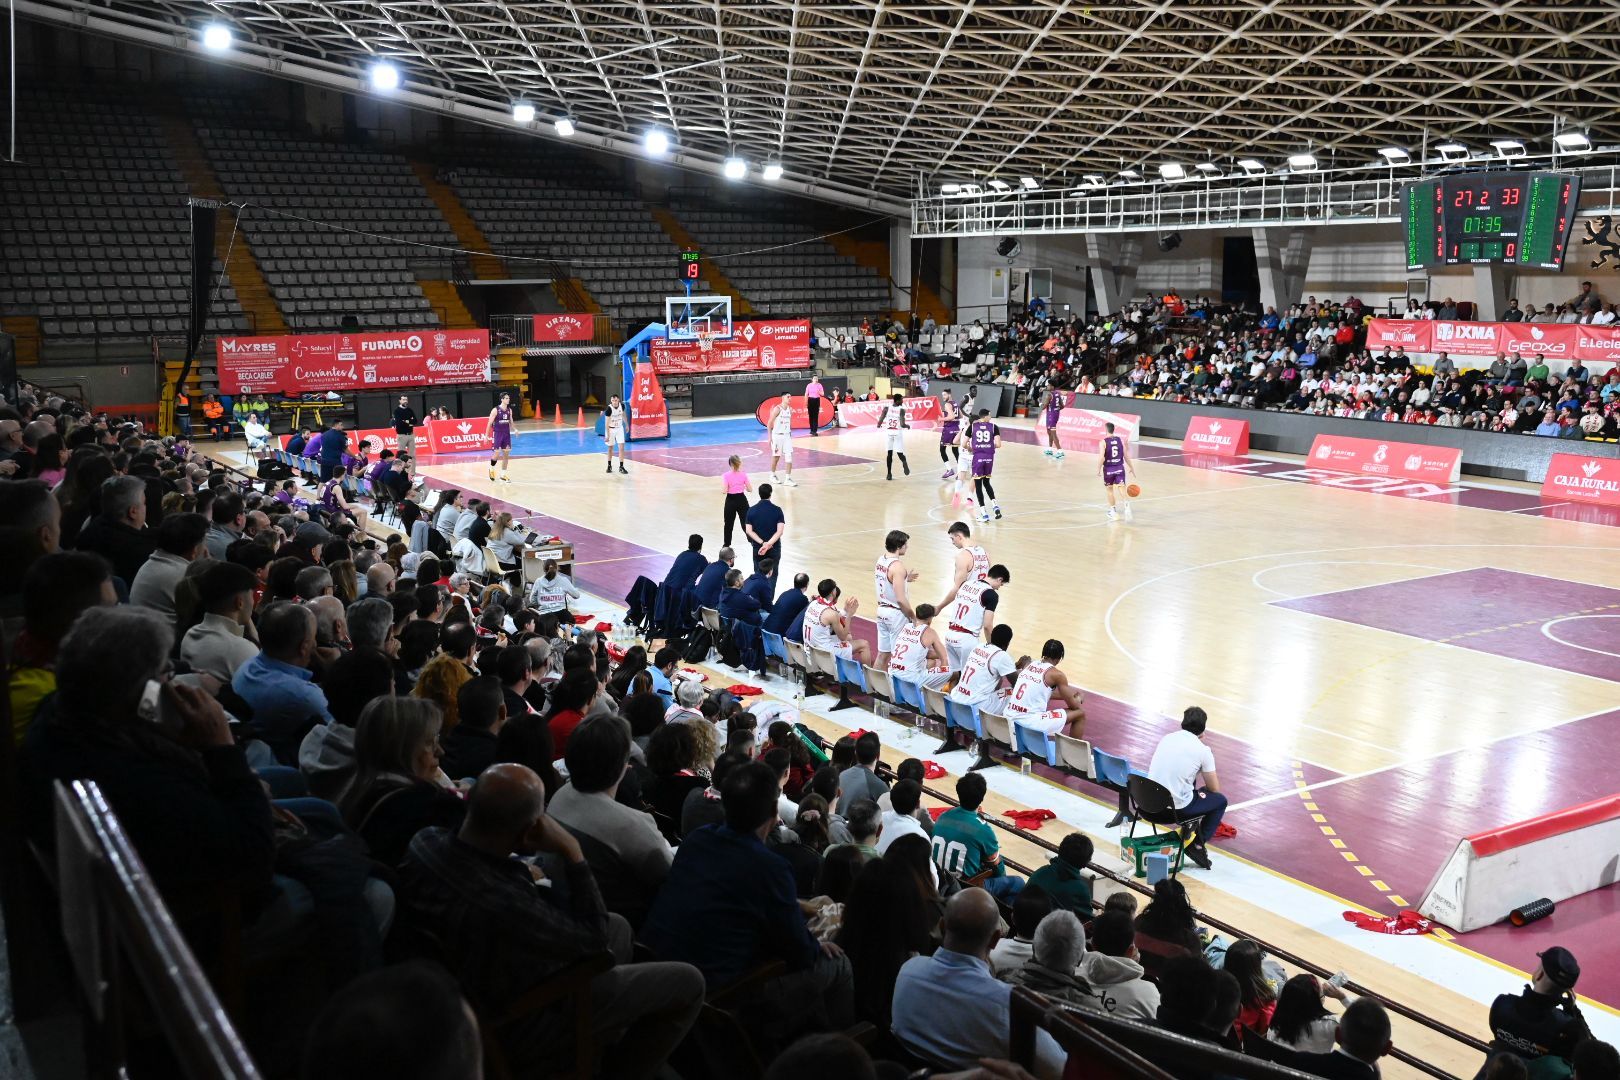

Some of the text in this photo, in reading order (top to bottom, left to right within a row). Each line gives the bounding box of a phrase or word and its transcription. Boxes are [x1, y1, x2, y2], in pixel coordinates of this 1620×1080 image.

[1455, 191, 1472, 207] 27
[1480, 191, 1489, 205] 2
[1502, 188, 1519, 205] 33
[1463, 216, 1501, 233] 07:35
[1453, 245, 1458, 257] 1
[1506, 243, 1515, 257] 0
[688, 263, 698, 278] 19
[545, 316, 582, 329] URZAPA
[774, 326, 807, 334] HYUNDAI
[1456, 325, 1496, 340] IXMA
[222, 340, 276, 352] MAYRES
[1508, 340, 1566, 353] Geoxa
[237, 371, 274, 380] BECA CABLES
[295, 365, 348, 380] Cervantes
[888, 418, 898, 427] 25
[442, 435, 463, 445] CAJA
[975, 430, 991, 443] 99
[1191, 433, 1232, 445] CAJA RURAL
[1111, 445, 1119, 458] 6
[1553, 474, 1620, 492] CAJA RURAL
[954, 603, 970, 621] 10
[804, 624, 811, 640] 11
[891, 643, 909, 661] 32
[961, 665, 976, 684] 17
[1015, 682, 1027, 701] 6
[931, 835, 968, 876] 00
